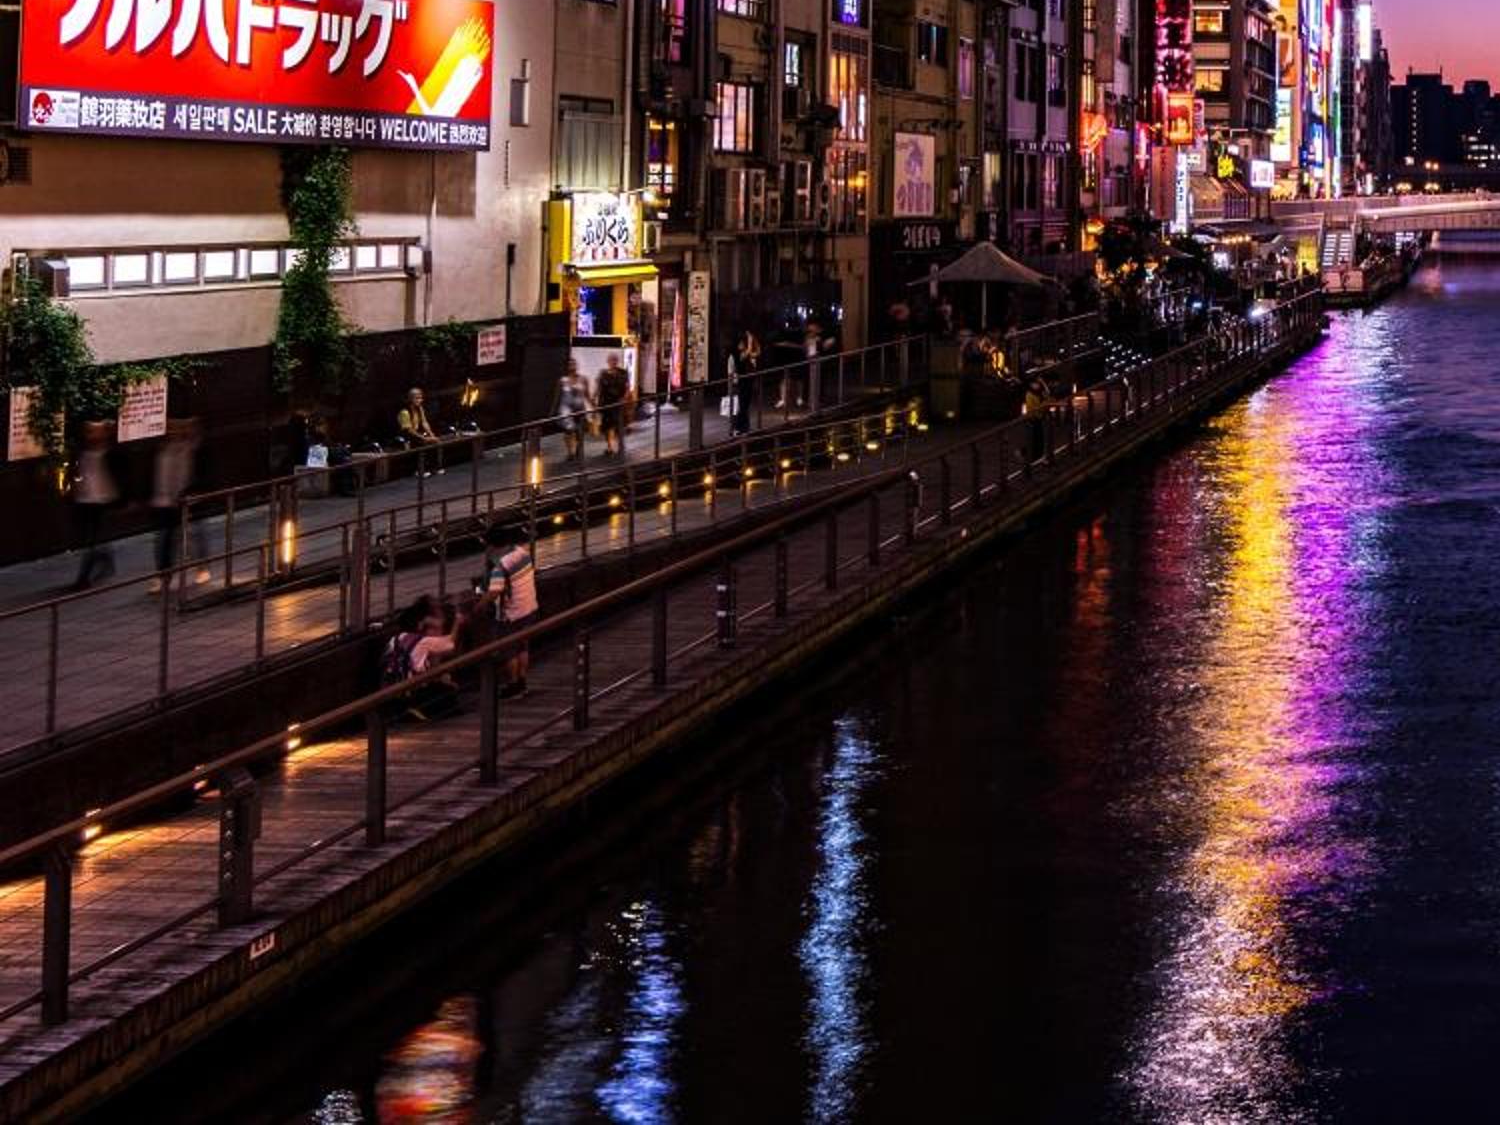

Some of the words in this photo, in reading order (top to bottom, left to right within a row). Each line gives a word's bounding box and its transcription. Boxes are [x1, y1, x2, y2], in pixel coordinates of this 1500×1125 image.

[173, 104, 230, 133] 세일판매
[233, 107, 276, 135] SALE
[320, 114, 376, 140] 환영합니다
[380, 118, 447, 144] WELCOME
